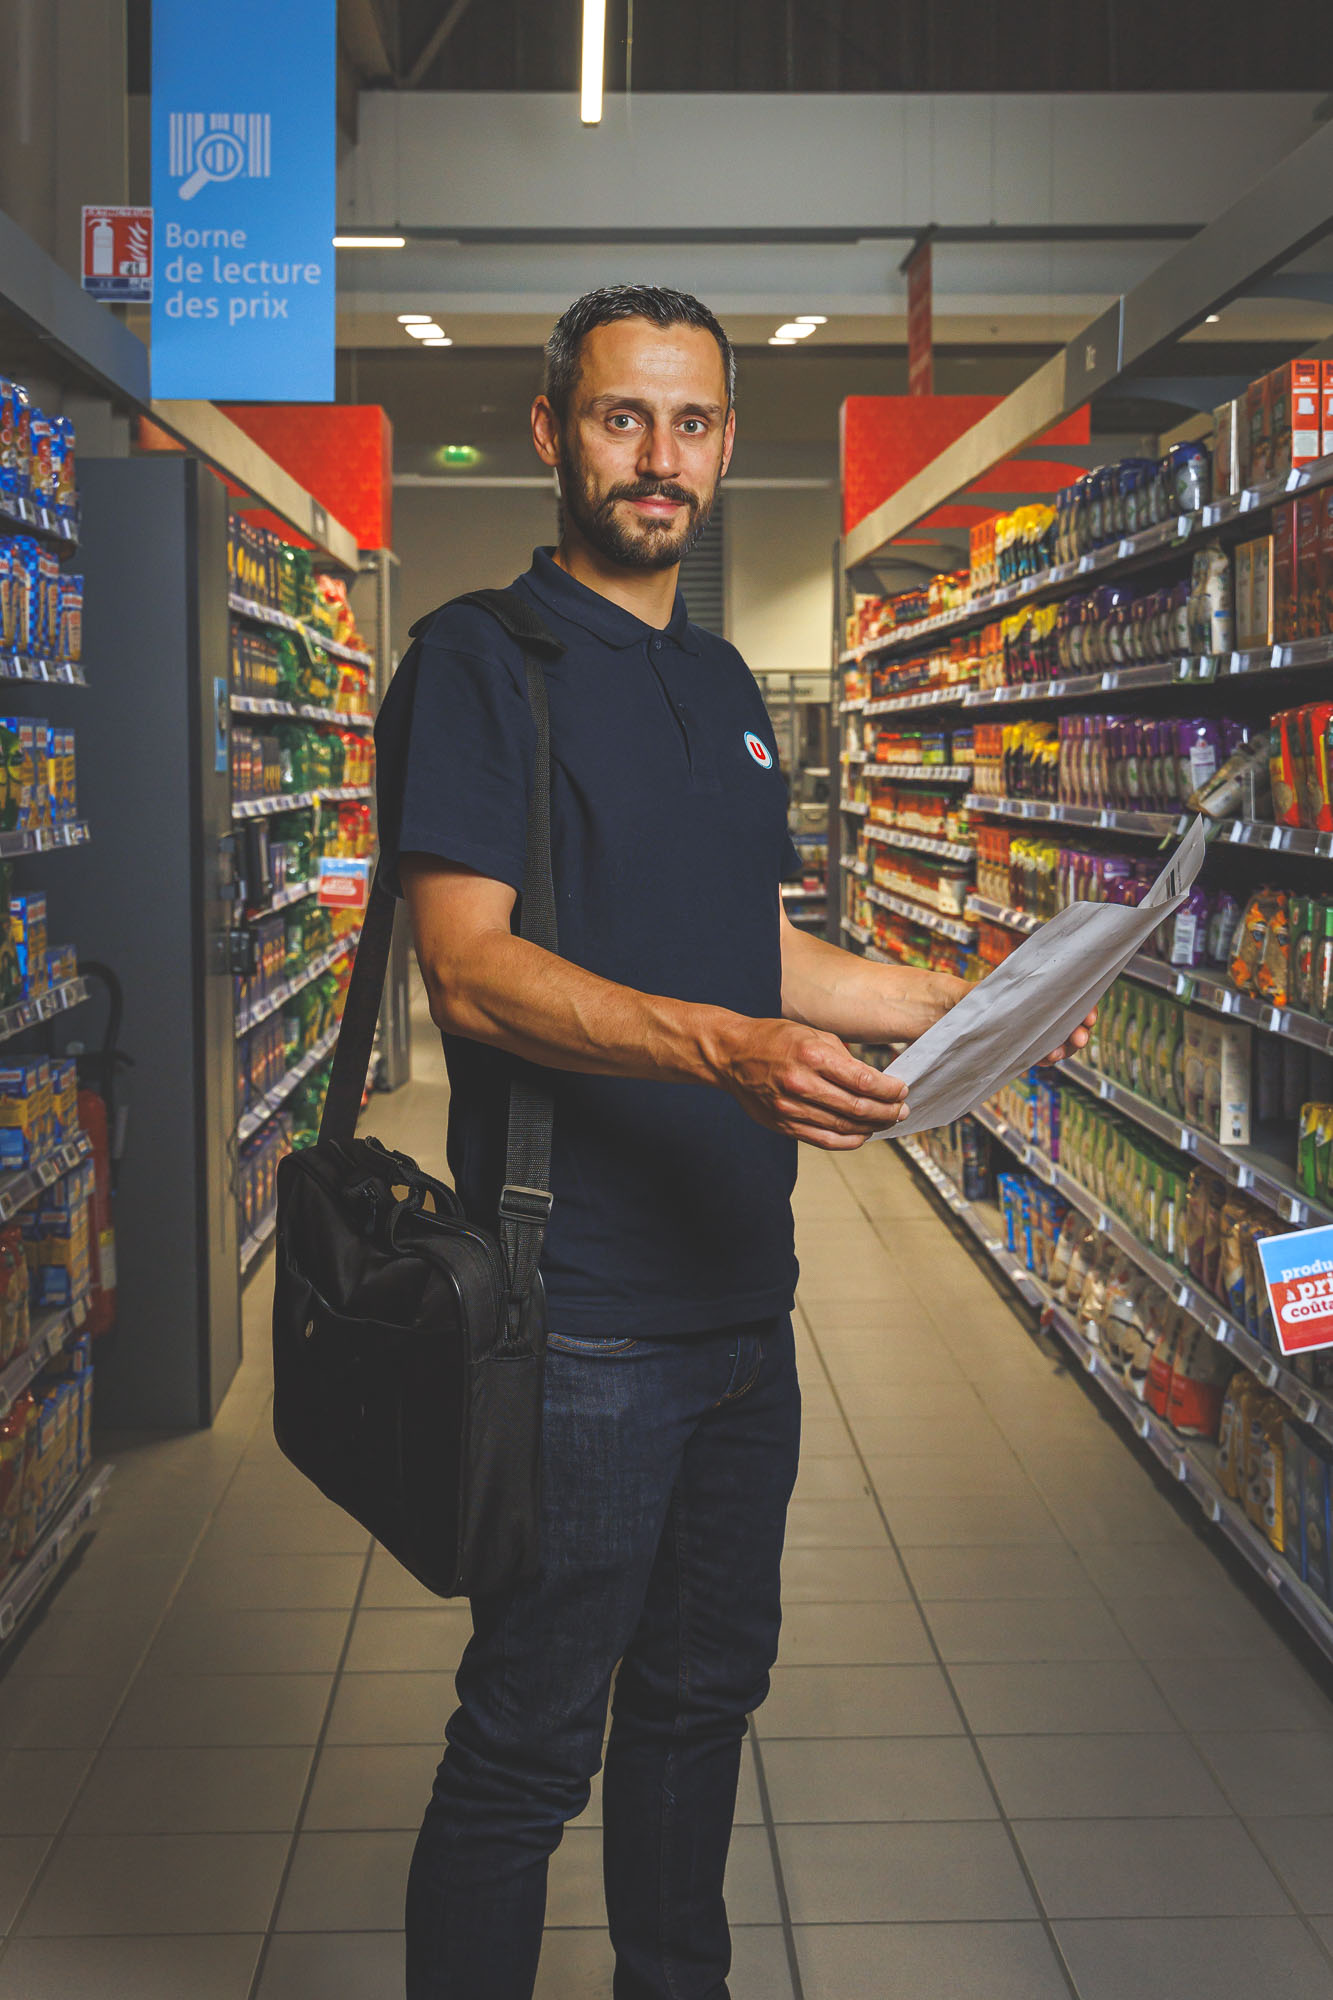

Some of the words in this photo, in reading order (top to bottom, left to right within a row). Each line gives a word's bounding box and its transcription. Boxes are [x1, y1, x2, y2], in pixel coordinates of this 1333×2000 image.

[165, 222, 247, 249] Borne
[165, 255, 203, 283] de
[213, 255, 322, 284] lecture
[165, 290, 219, 318] des
[229, 290, 289, 326] prix
[749, 741, 766, 761] U
